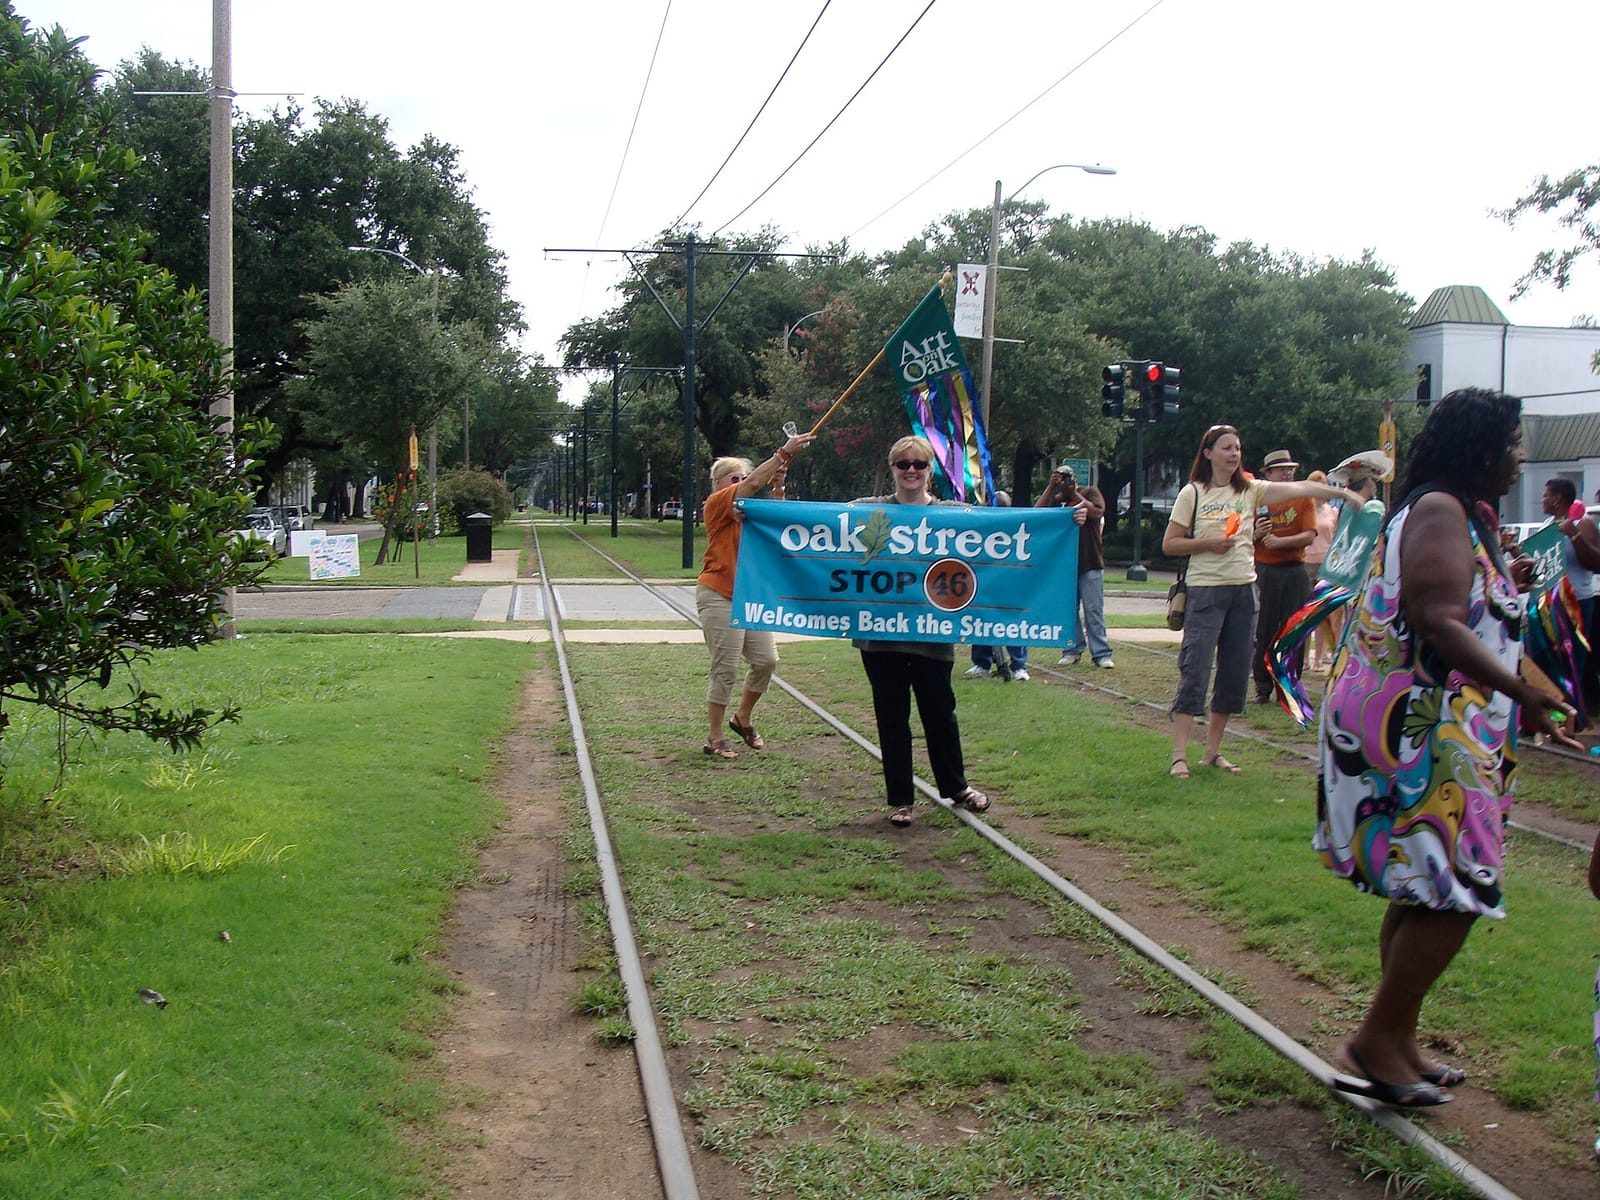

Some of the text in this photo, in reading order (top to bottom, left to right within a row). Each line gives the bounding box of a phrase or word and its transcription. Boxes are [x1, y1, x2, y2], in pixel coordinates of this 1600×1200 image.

[900, 331, 952, 367] Art
[903, 347, 960, 382] Oak
[922, 351, 938, 361] on
[780, 512, 1032, 561] oak street
[829, 569, 969, 598] STOP 46
[745, 602, 1063, 641] Welcomes Back the Streetcar
